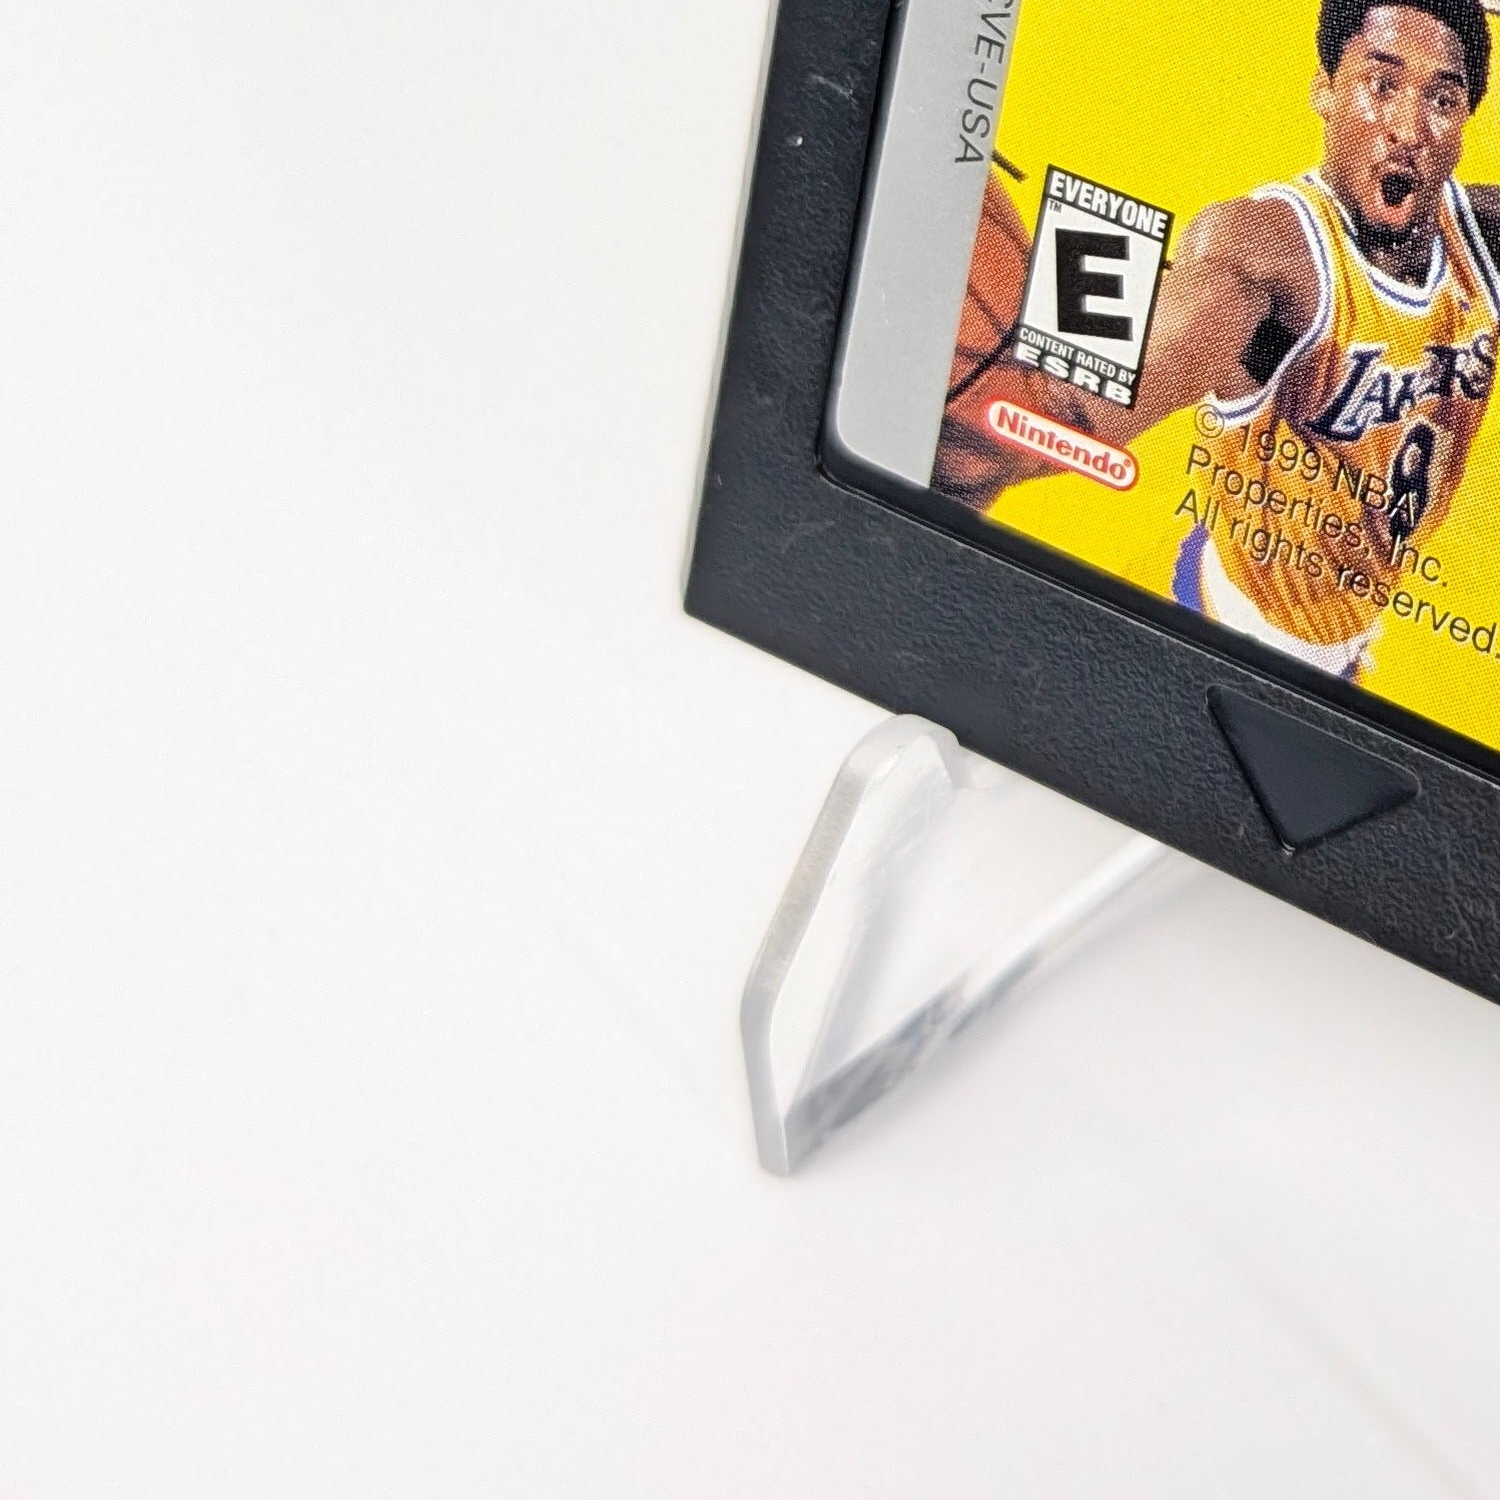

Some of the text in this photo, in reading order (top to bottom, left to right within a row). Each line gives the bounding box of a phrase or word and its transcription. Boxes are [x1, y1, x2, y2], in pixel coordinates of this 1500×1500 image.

[1050, 170, 1168, 238] EVERYONE
[1055, 228, 1133, 341] E
[1015, 343, 1132, 405] ESRB
[1019, 327, 1136, 386] CONTENT RATED BY
[1186, 444, 1448, 588] Properties, Inc.
[1241, 424, 1322, 481] 1999
[1333, 459, 1416, 526] NBA
[1175, 489, 1221, 531] All
[1229, 516, 1324, 578] rights
